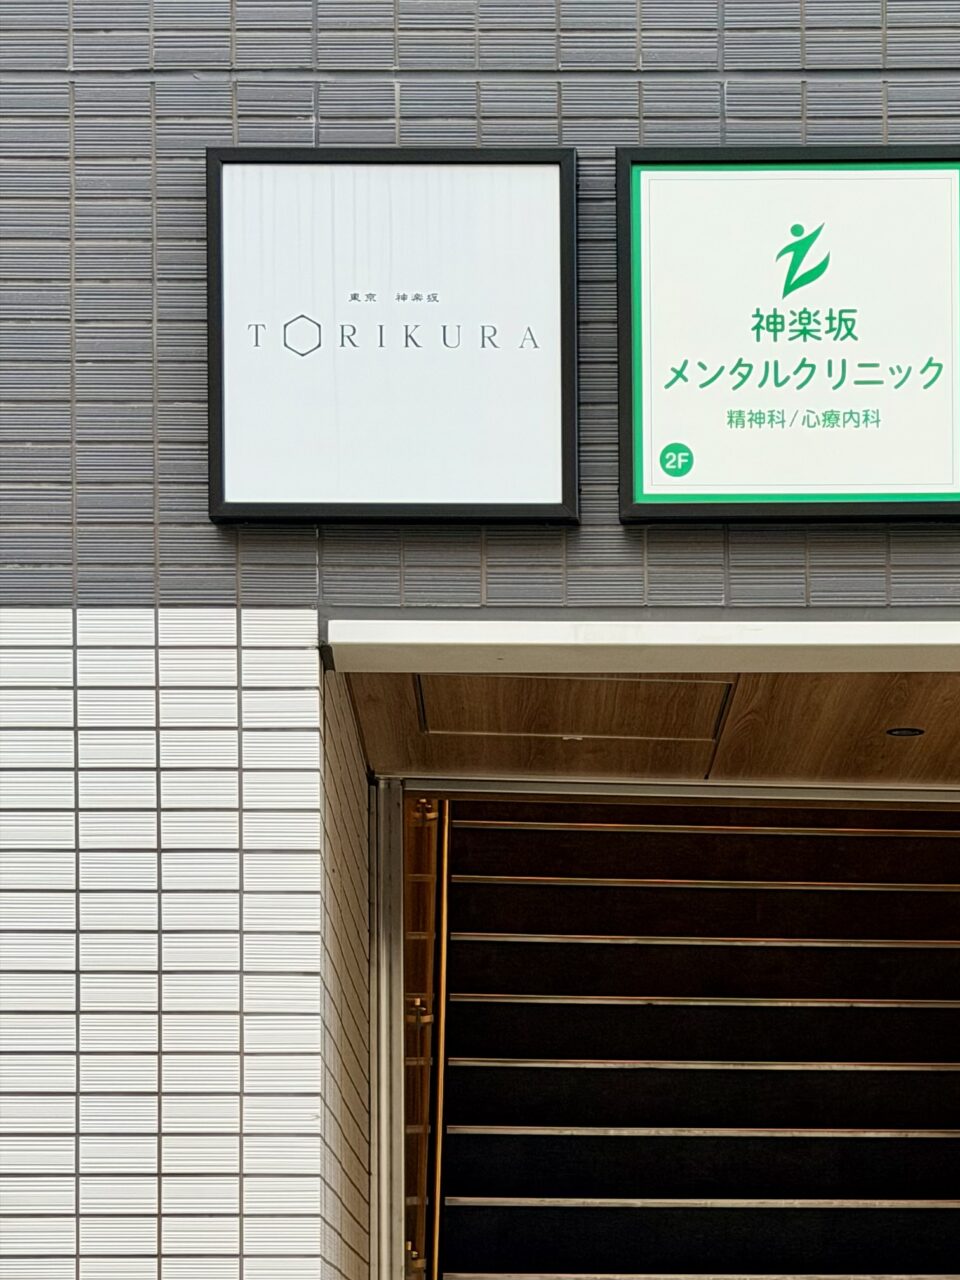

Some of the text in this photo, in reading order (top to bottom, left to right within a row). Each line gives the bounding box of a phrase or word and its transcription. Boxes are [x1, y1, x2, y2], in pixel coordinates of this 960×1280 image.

[348, 293, 377, 302] 東京
[248, 314, 540, 357] TORIKURA
[751, 307, 859, 343] 神楽坂
[663, 356, 944, 391] メンタルクリニック
[727, 409, 881, 429] 精神科/心療内科
[665, 452, 690, 470] 2F
